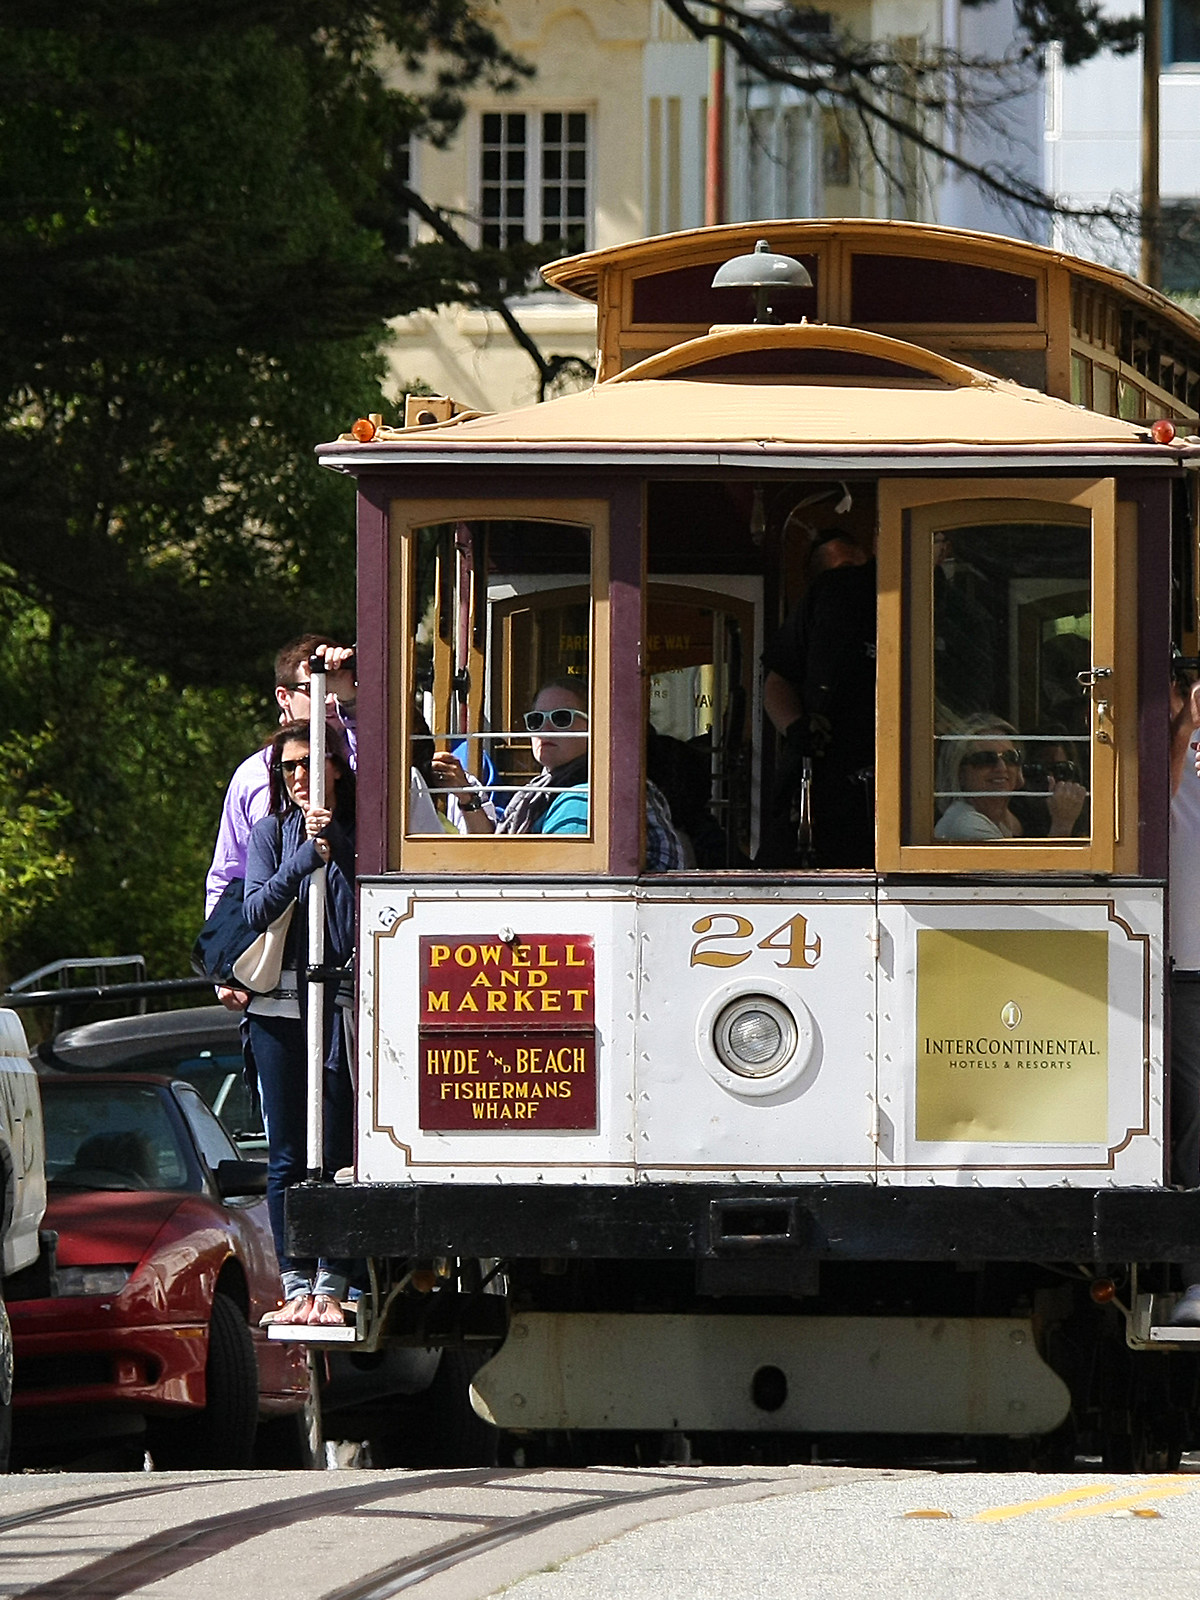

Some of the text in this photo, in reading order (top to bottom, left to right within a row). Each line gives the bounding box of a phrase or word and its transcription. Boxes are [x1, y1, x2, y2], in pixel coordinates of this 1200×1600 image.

[690, 912, 822, 969] 24
[429, 944, 586, 968] POWELL
[470, 969, 549, 987] AND
[426, 989, 589, 1012] MARKET
[427, 1047, 586, 1075] HYDE AND BEACH
[949, 1060, 1072, 1070] HOTELS & RESORTS
[440, 1080, 572, 1100] FISHERMANS
[472, 1102, 540, 1120] WHARF
